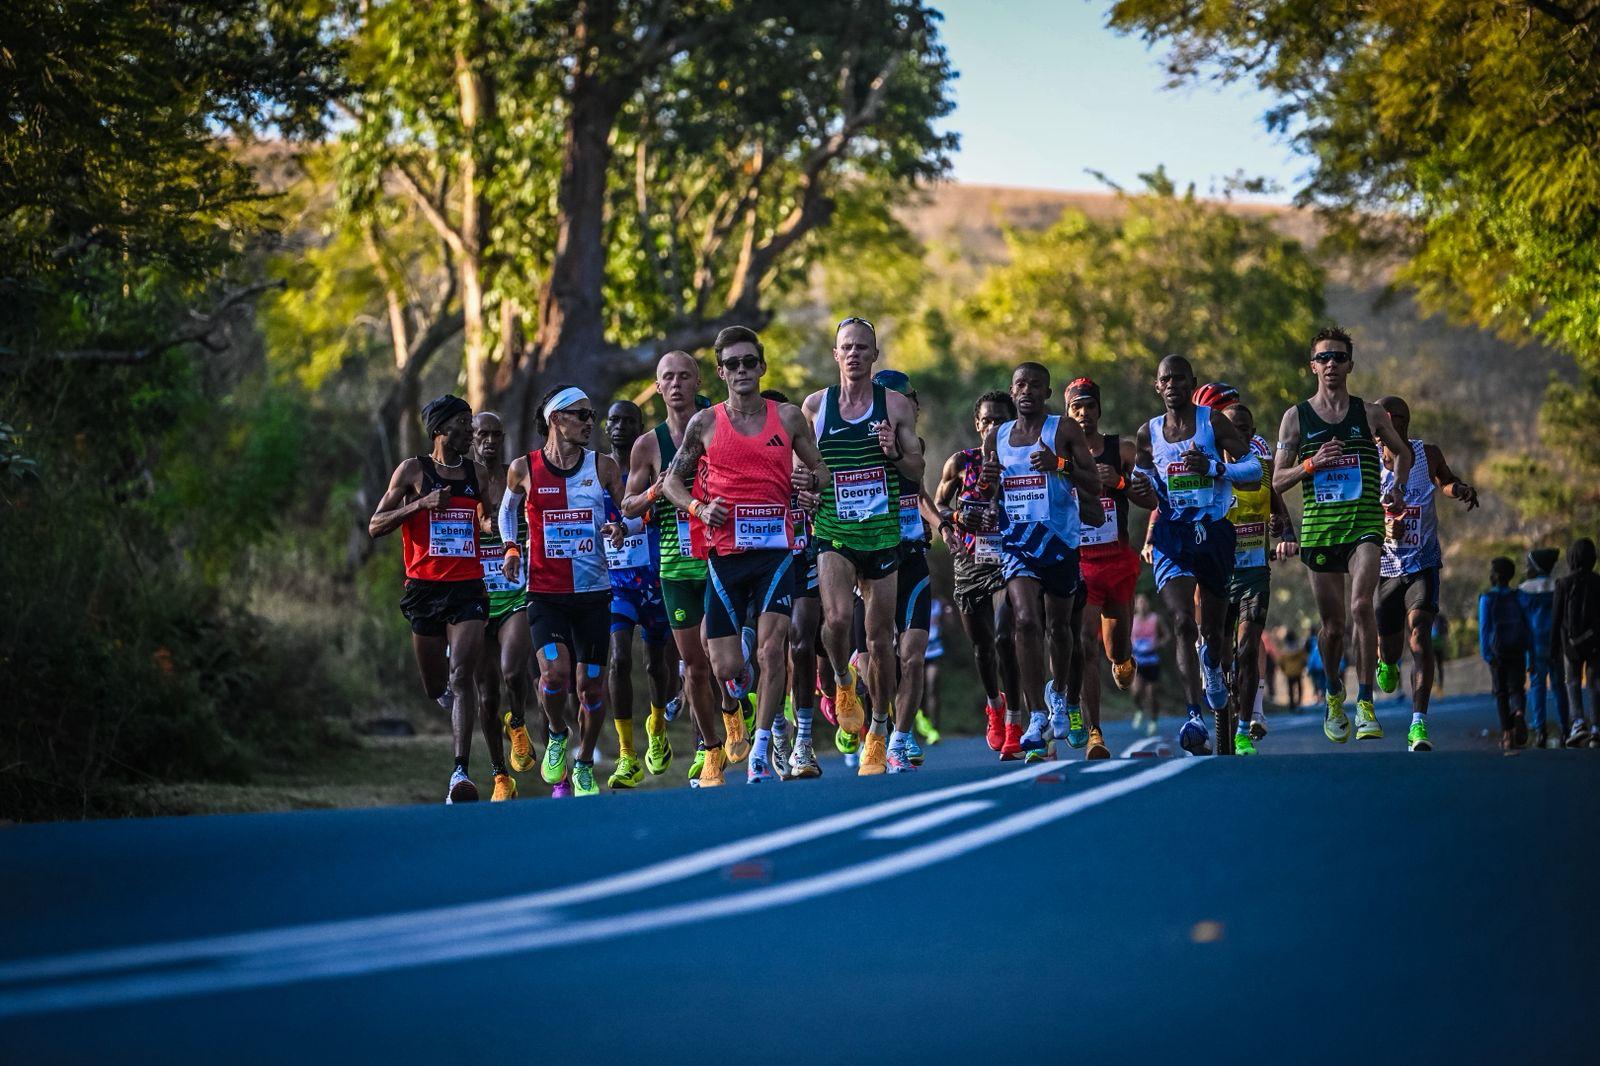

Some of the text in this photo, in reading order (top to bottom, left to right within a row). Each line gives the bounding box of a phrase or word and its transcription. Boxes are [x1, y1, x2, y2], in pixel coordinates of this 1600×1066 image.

[838, 471, 881, 481] THIRSTI
[1005, 477, 1042, 486] THIRSTI
[1327, 473, 1350, 482] Alex
[1172, 478, 1209, 489] Sanele
[841, 486, 882, 499] George
[1007, 491, 1045, 502] Ntsindiso
[547, 512, 589, 520] THIRSTI
[739, 508, 781, 516] THIRSTI
[556, 527, 582, 537] Toru
[740, 522, 782, 534] Charles
[607, 538, 643, 549] Togo
[1404, 533, 1419, 545] 40
[463, 541, 474, 554] 40
[578, 538, 594, 553] 40
